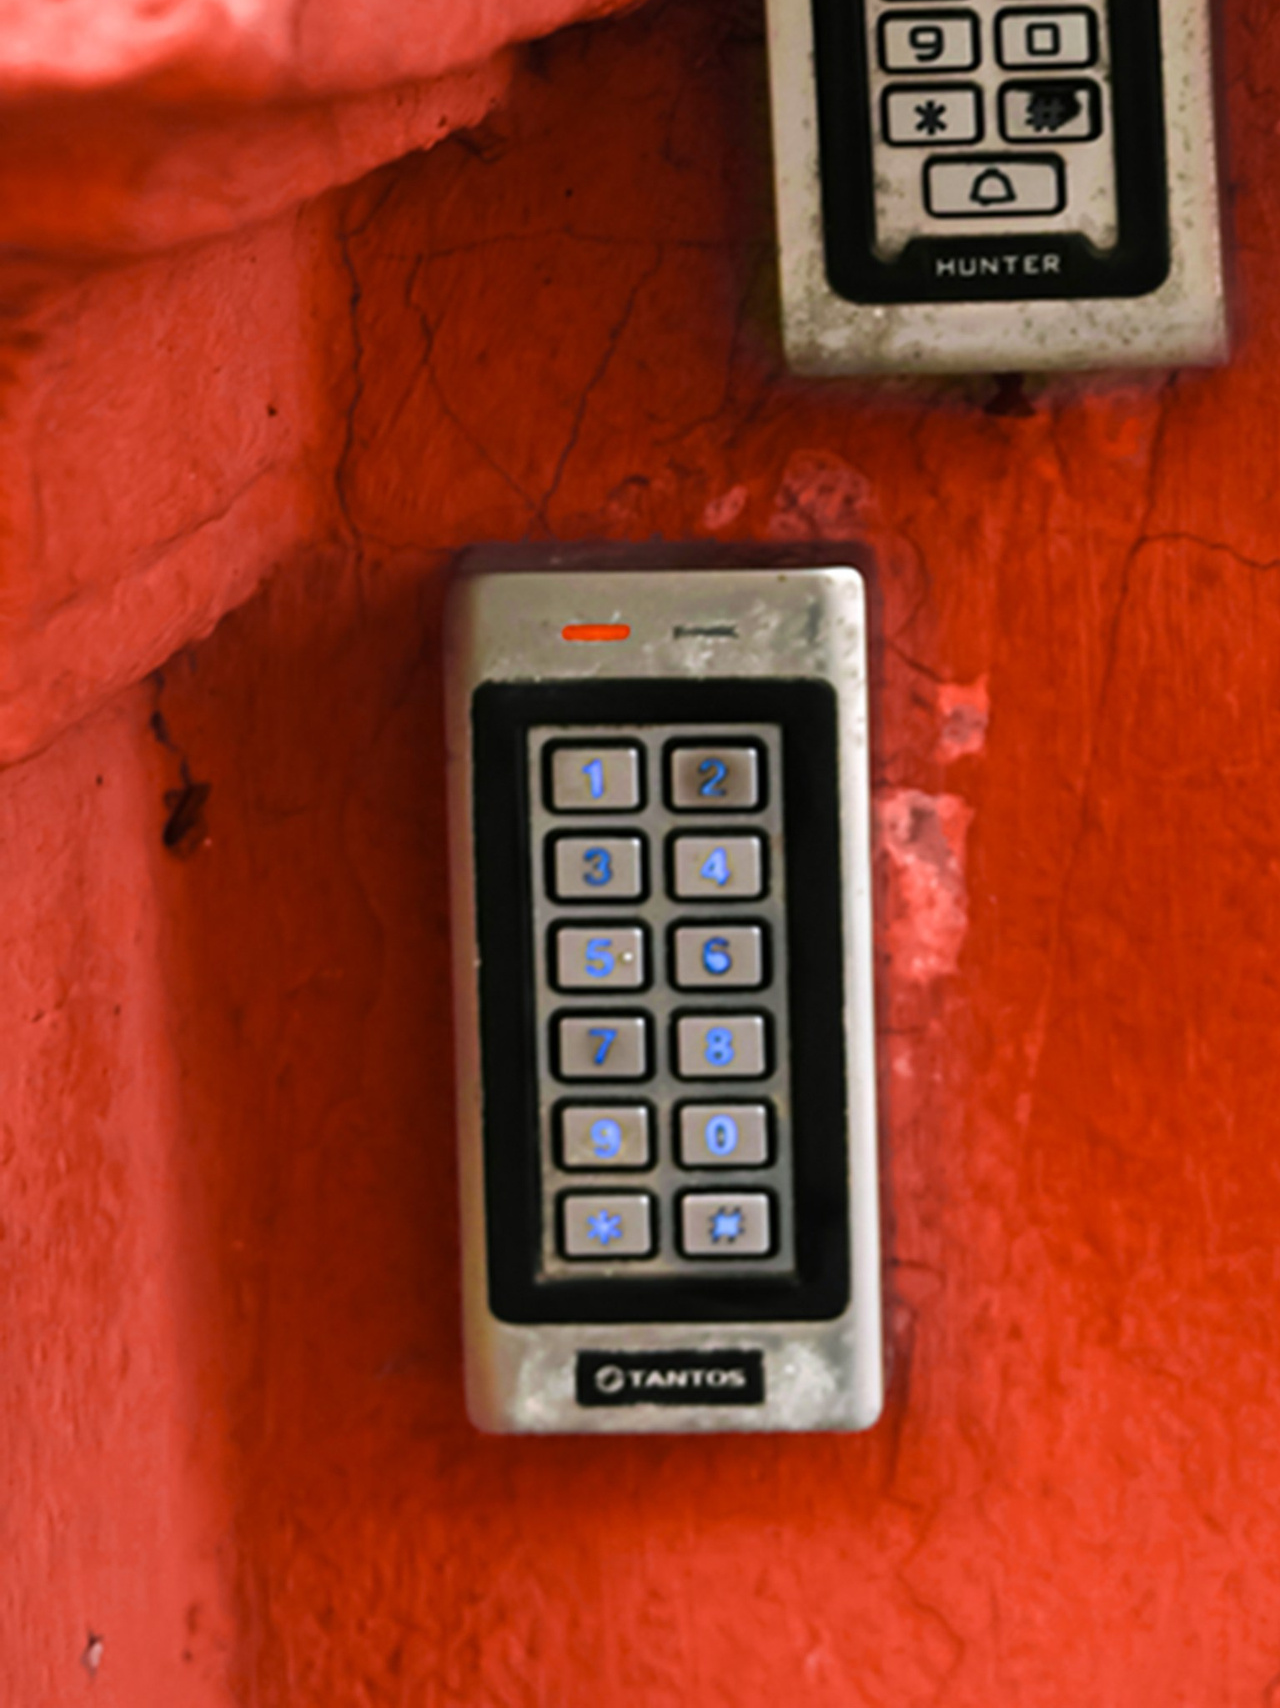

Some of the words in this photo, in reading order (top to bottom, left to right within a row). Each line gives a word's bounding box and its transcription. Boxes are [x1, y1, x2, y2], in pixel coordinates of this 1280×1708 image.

[909, 25, 944, 61] 9
[935, 254, 1061, 277] HUNTER
[582, 759, 605, 799] 1
[699, 759, 729, 797] 2
[583, 847, 613, 887] 3
[700, 847, 731, 887] 4
[584, 938, 616, 979] 5
[702, 938, 732, 976] 6
[588, 1028, 619, 1066] 7
[704, 1027, 735, 1066] 8
[590, 1118, 623, 1158] 9
[704, 1114, 739, 1156] 0
[629, 1366, 746, 1389] TANTOS
